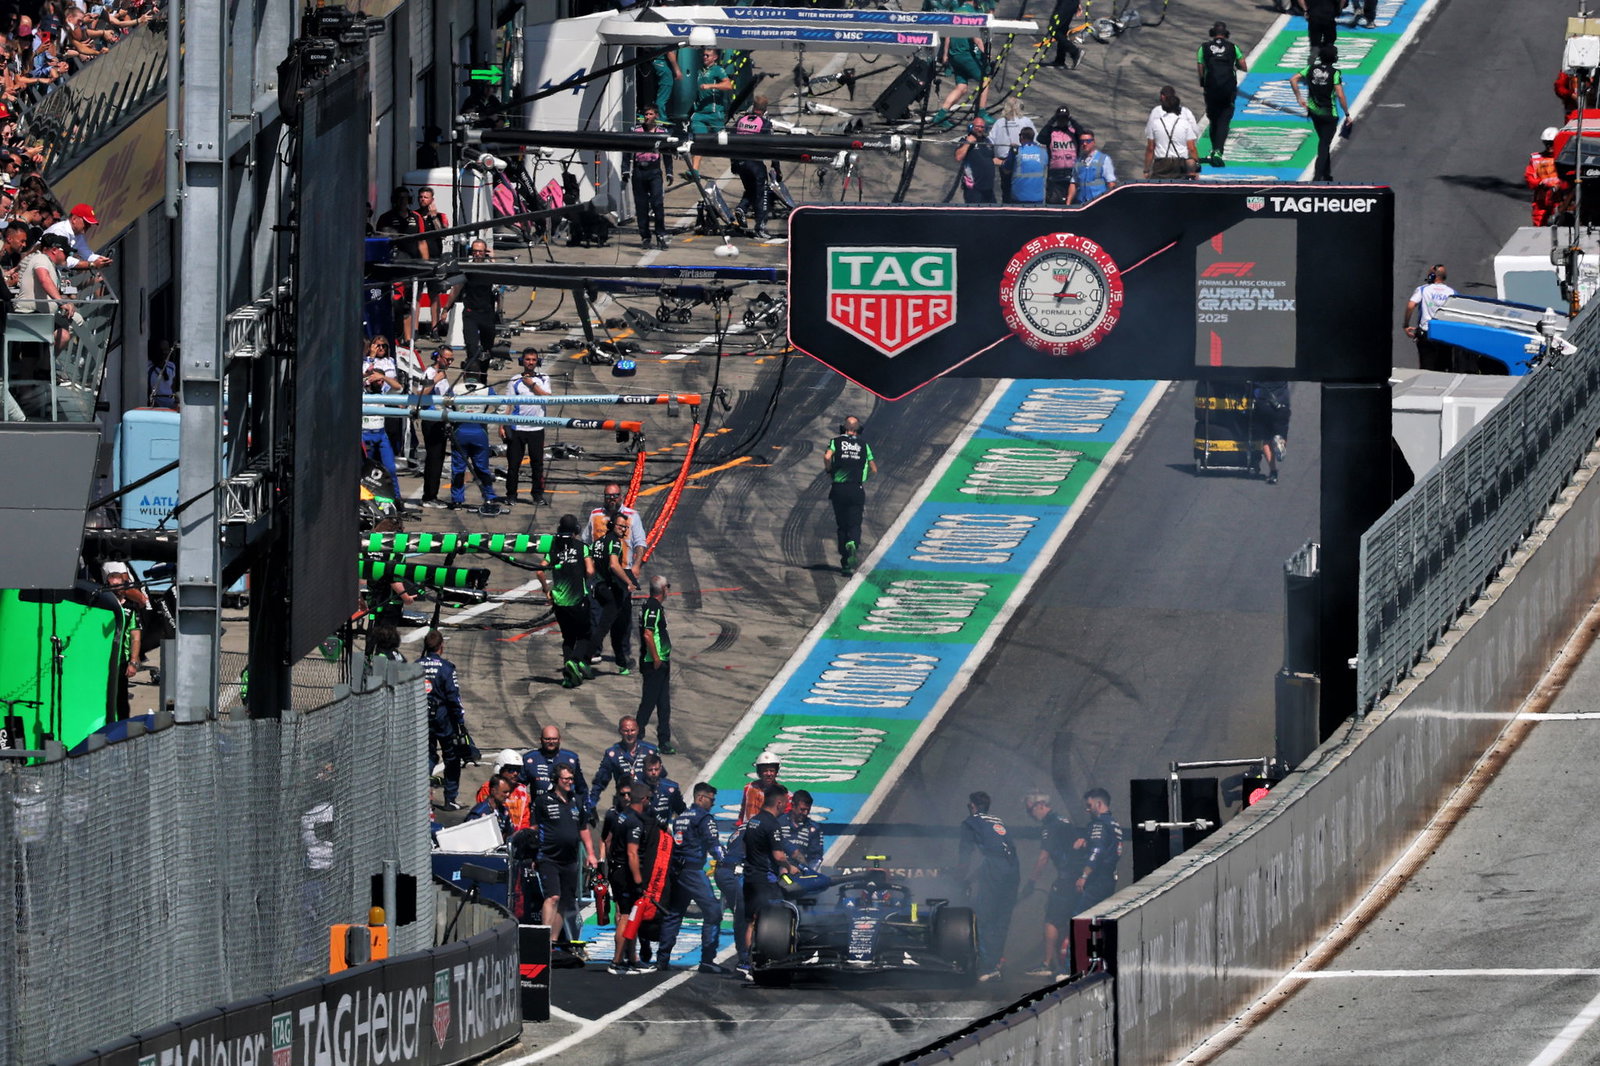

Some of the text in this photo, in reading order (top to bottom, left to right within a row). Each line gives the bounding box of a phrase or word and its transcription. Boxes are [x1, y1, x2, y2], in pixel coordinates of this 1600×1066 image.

[907, 36, 928, 44] BWT
[1053, 141, 1074, 149] BWT
[1026, 240, 1041, 253] 55
[838, 256, 944, 287] TAG
[1007, 259, 1020, 273] 50
[1200, 262, 1256, 277] F1
[1001, 287, 1009, 302] 45
[1198, 288, 1274, 299] AUSTRIAN
[1198, 300, 1296, 311] GRAND PRIX
[836, 297, 947, 347] HEUER
[1198, 314, 1228, 322] 2025
[572, 420, 598, 428] Gulf
